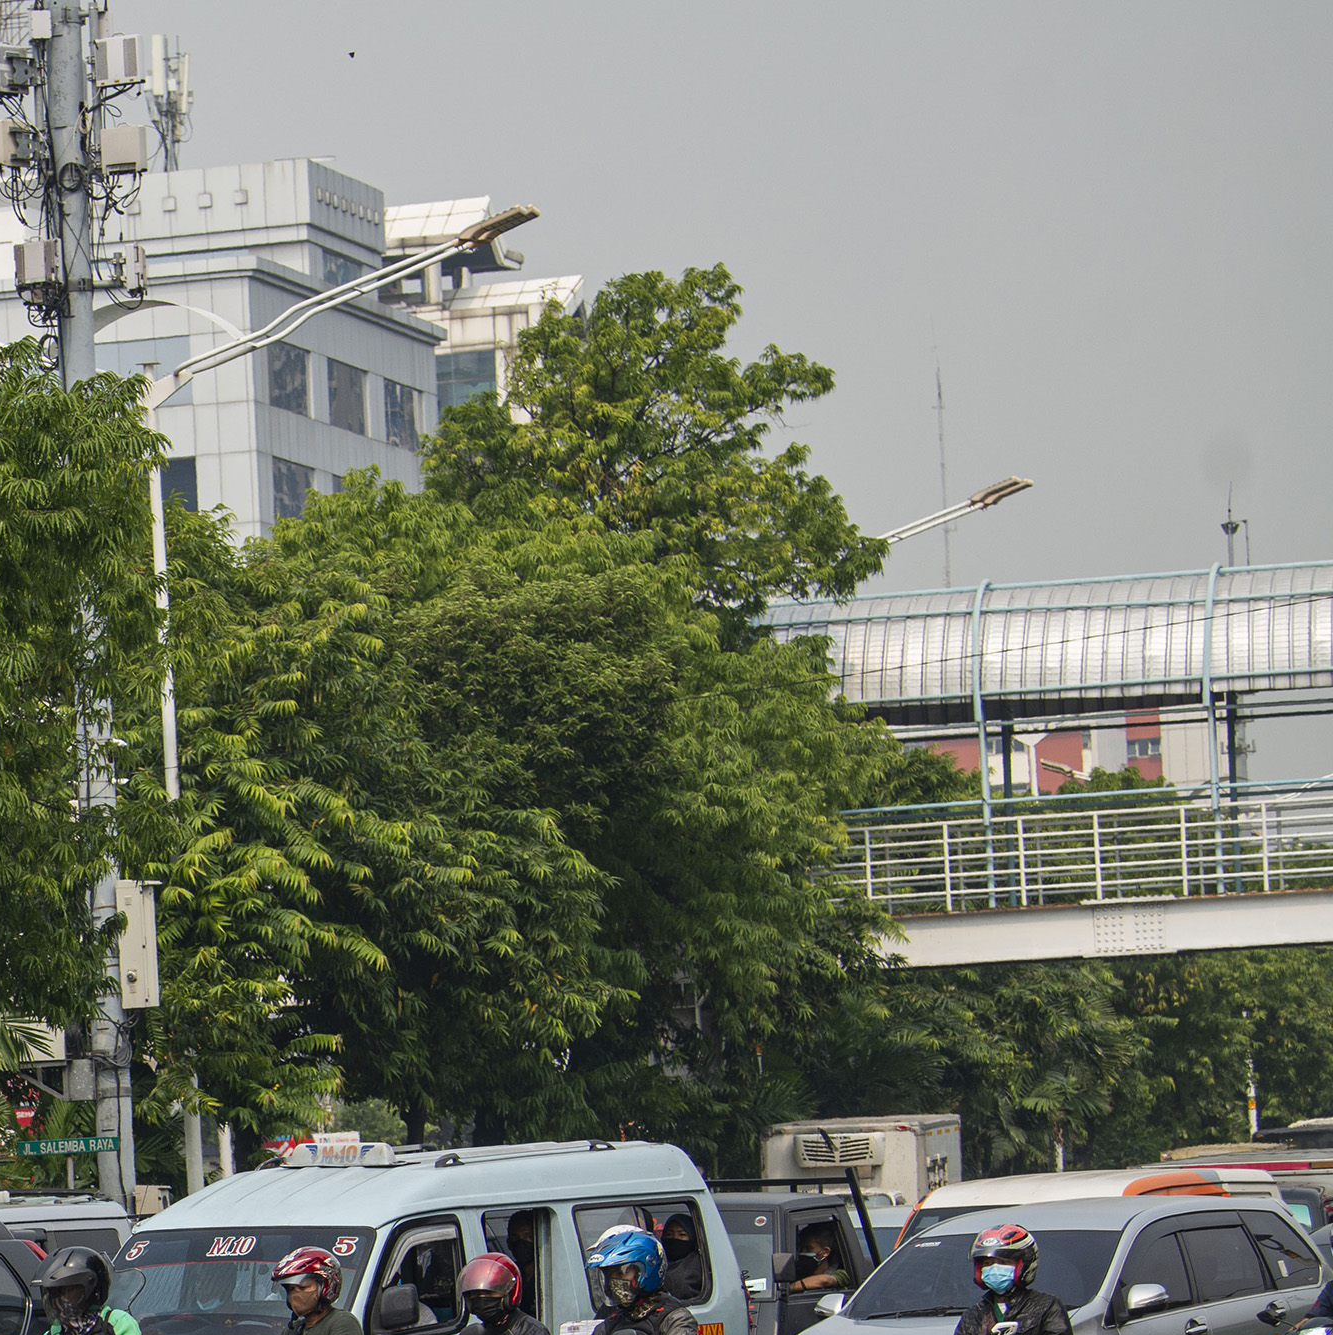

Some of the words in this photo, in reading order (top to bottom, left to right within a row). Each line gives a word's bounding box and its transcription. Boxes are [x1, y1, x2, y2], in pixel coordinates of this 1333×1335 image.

[23, 1144, 37, 1155] JL.
[40, 1140, 86, 1154] SALEMBA
[89, 1138, 115, 1151] RAYA
[126, 1240, 150, 1261] 5
[333, 1236, 359, 1257] 5
